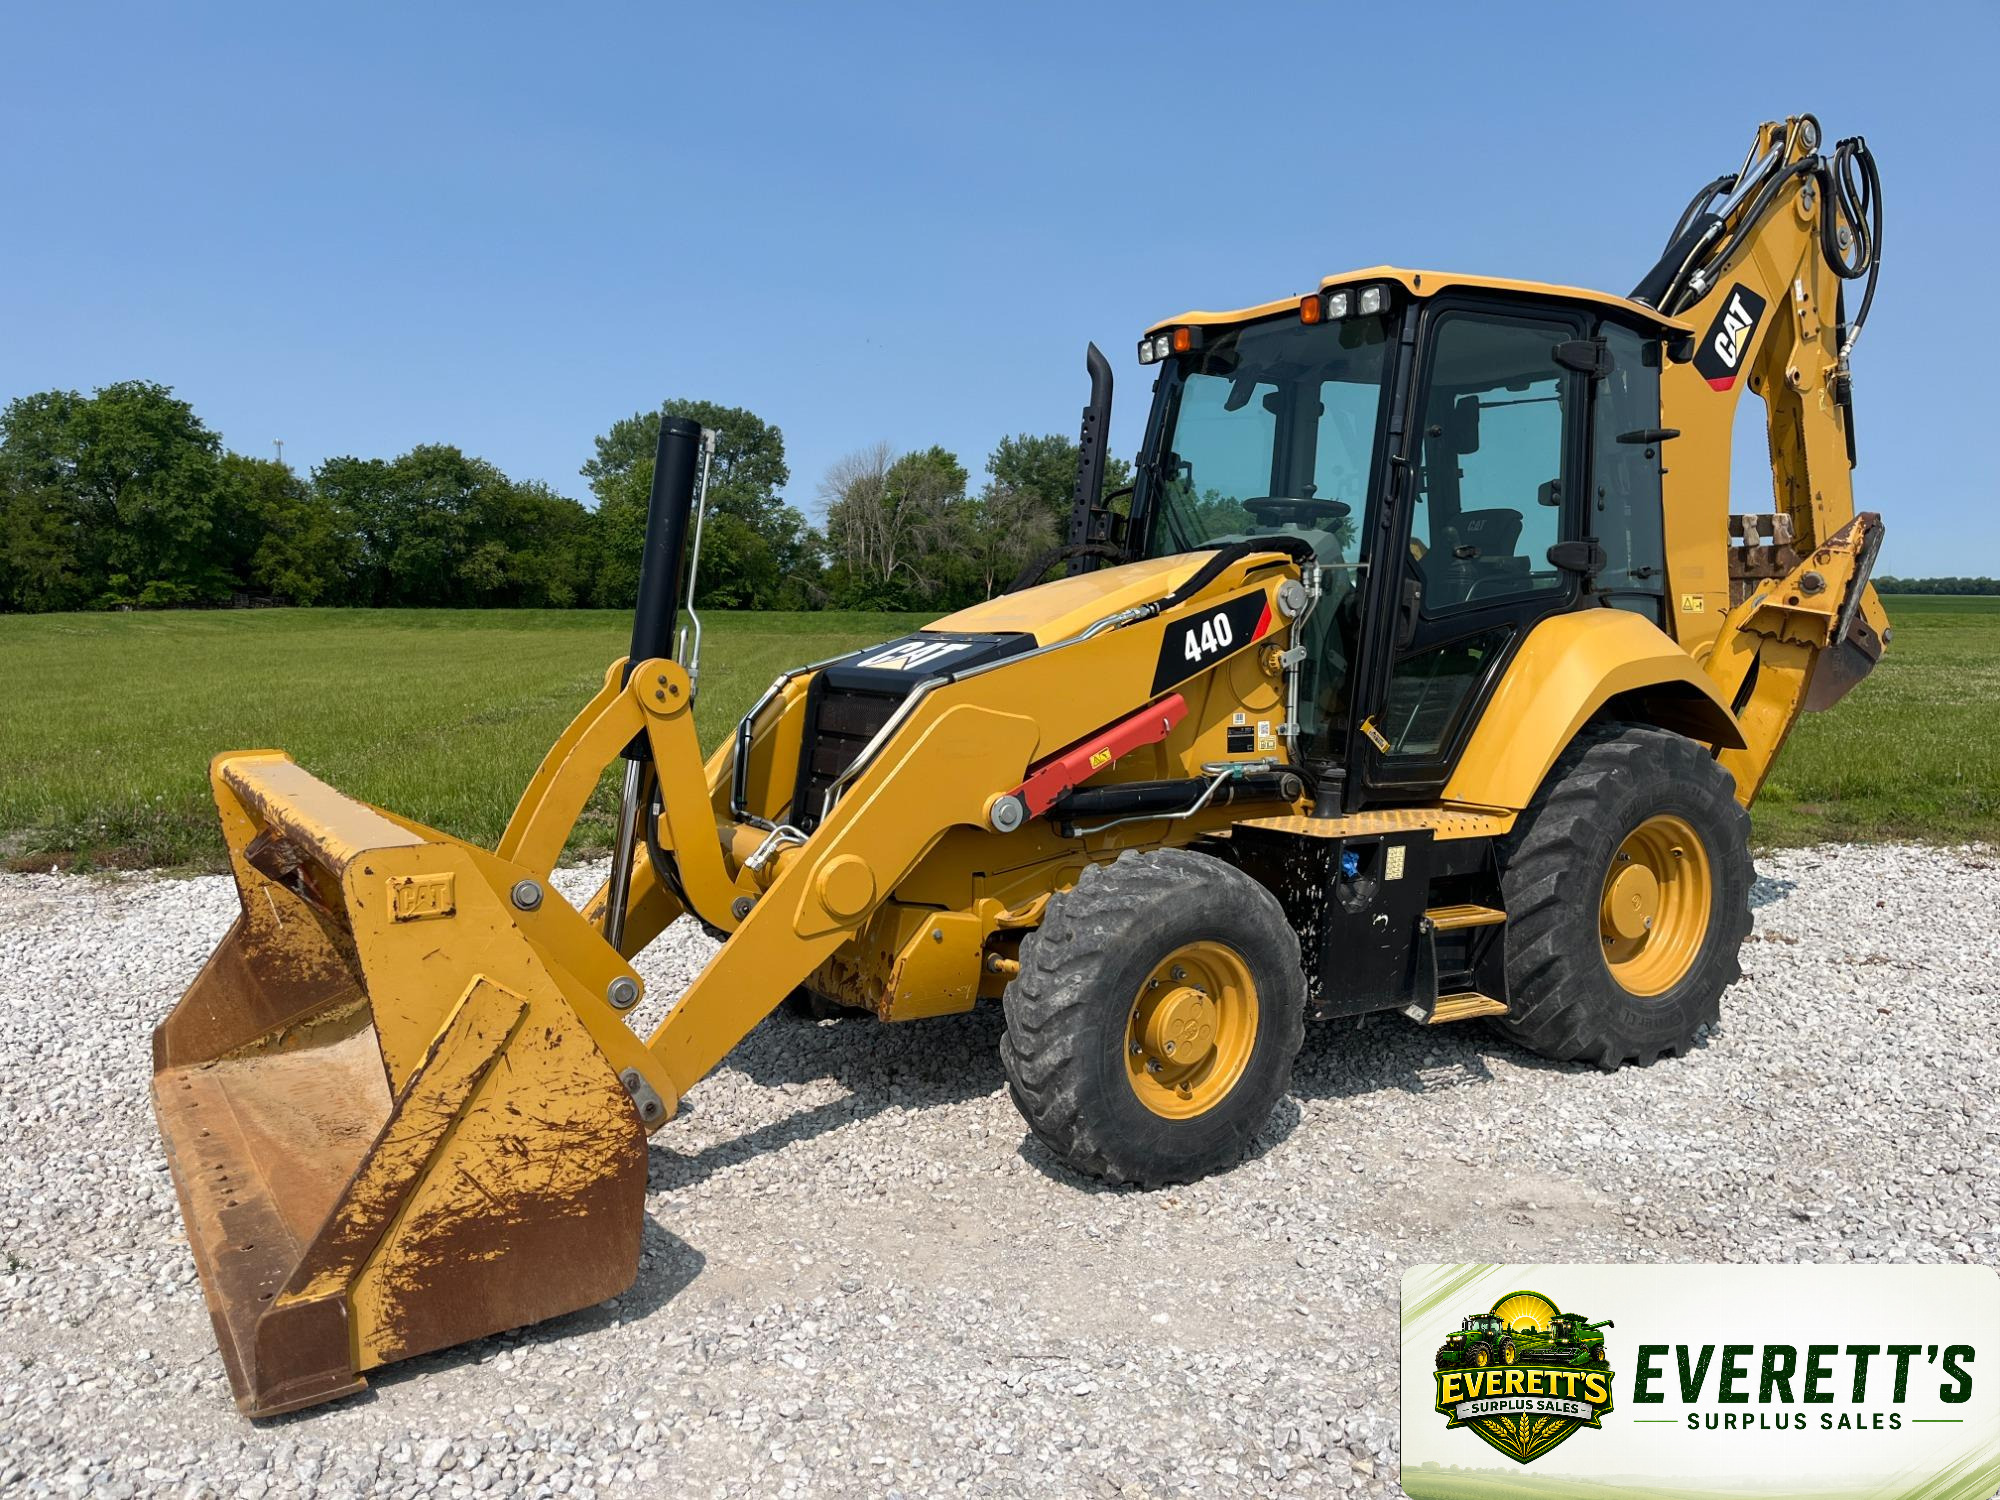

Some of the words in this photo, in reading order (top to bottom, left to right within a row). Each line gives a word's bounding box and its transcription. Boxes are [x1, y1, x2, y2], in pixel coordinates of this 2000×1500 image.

[1714, 292, 1753, 368] CAT
[1467, 520, 1488, 532] CAT
[1184, 612, 1233, 662] 440
[857, 641, 973, 671] CAT
[397, 884, 447, 915] CAT
